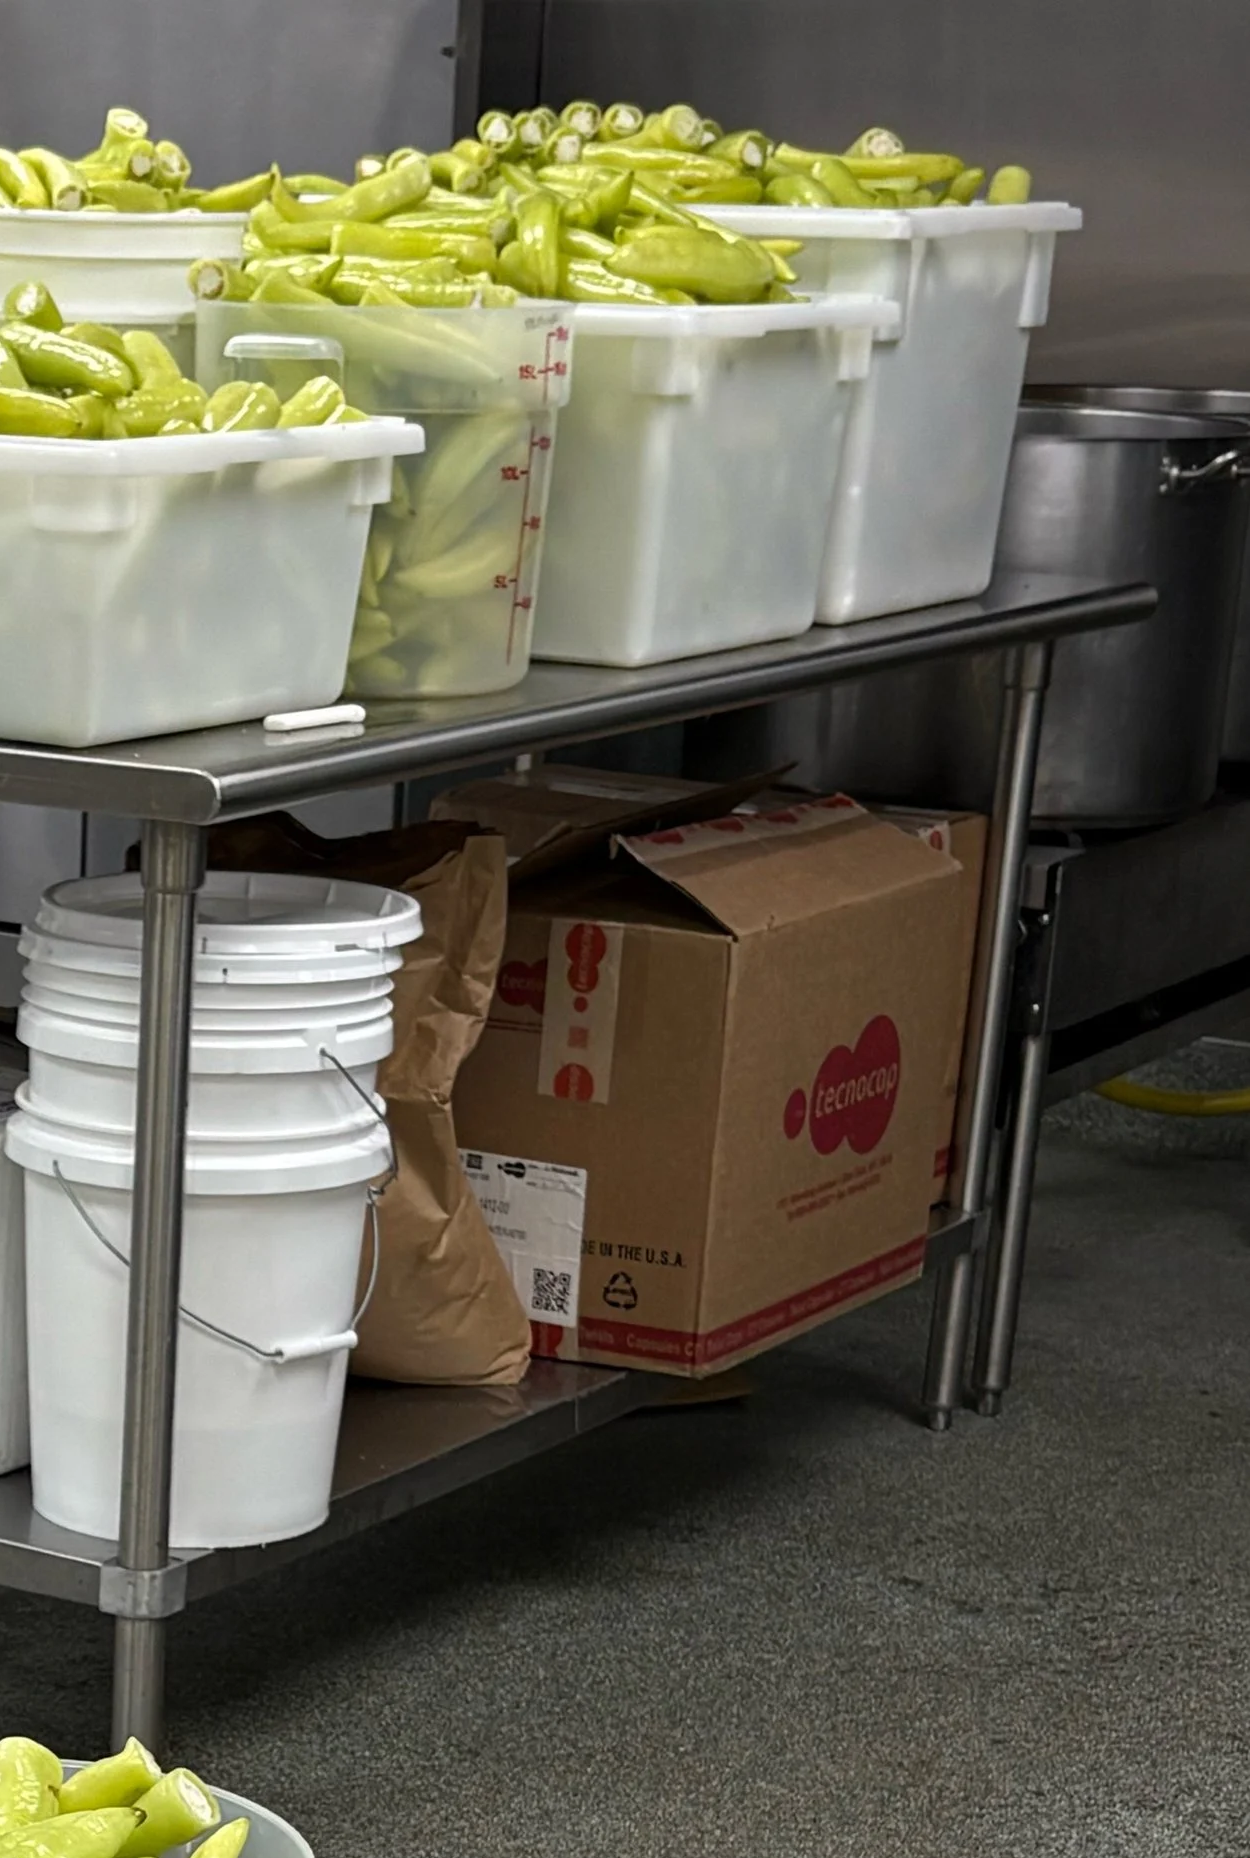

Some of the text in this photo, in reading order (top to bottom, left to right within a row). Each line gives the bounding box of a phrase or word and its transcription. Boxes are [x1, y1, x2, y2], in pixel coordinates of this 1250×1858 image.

[599, 1242, 613, 1257] IN
[617, 1244, 643, 1262] THE
[646, 1248, 687, 1268] U.S.A.
